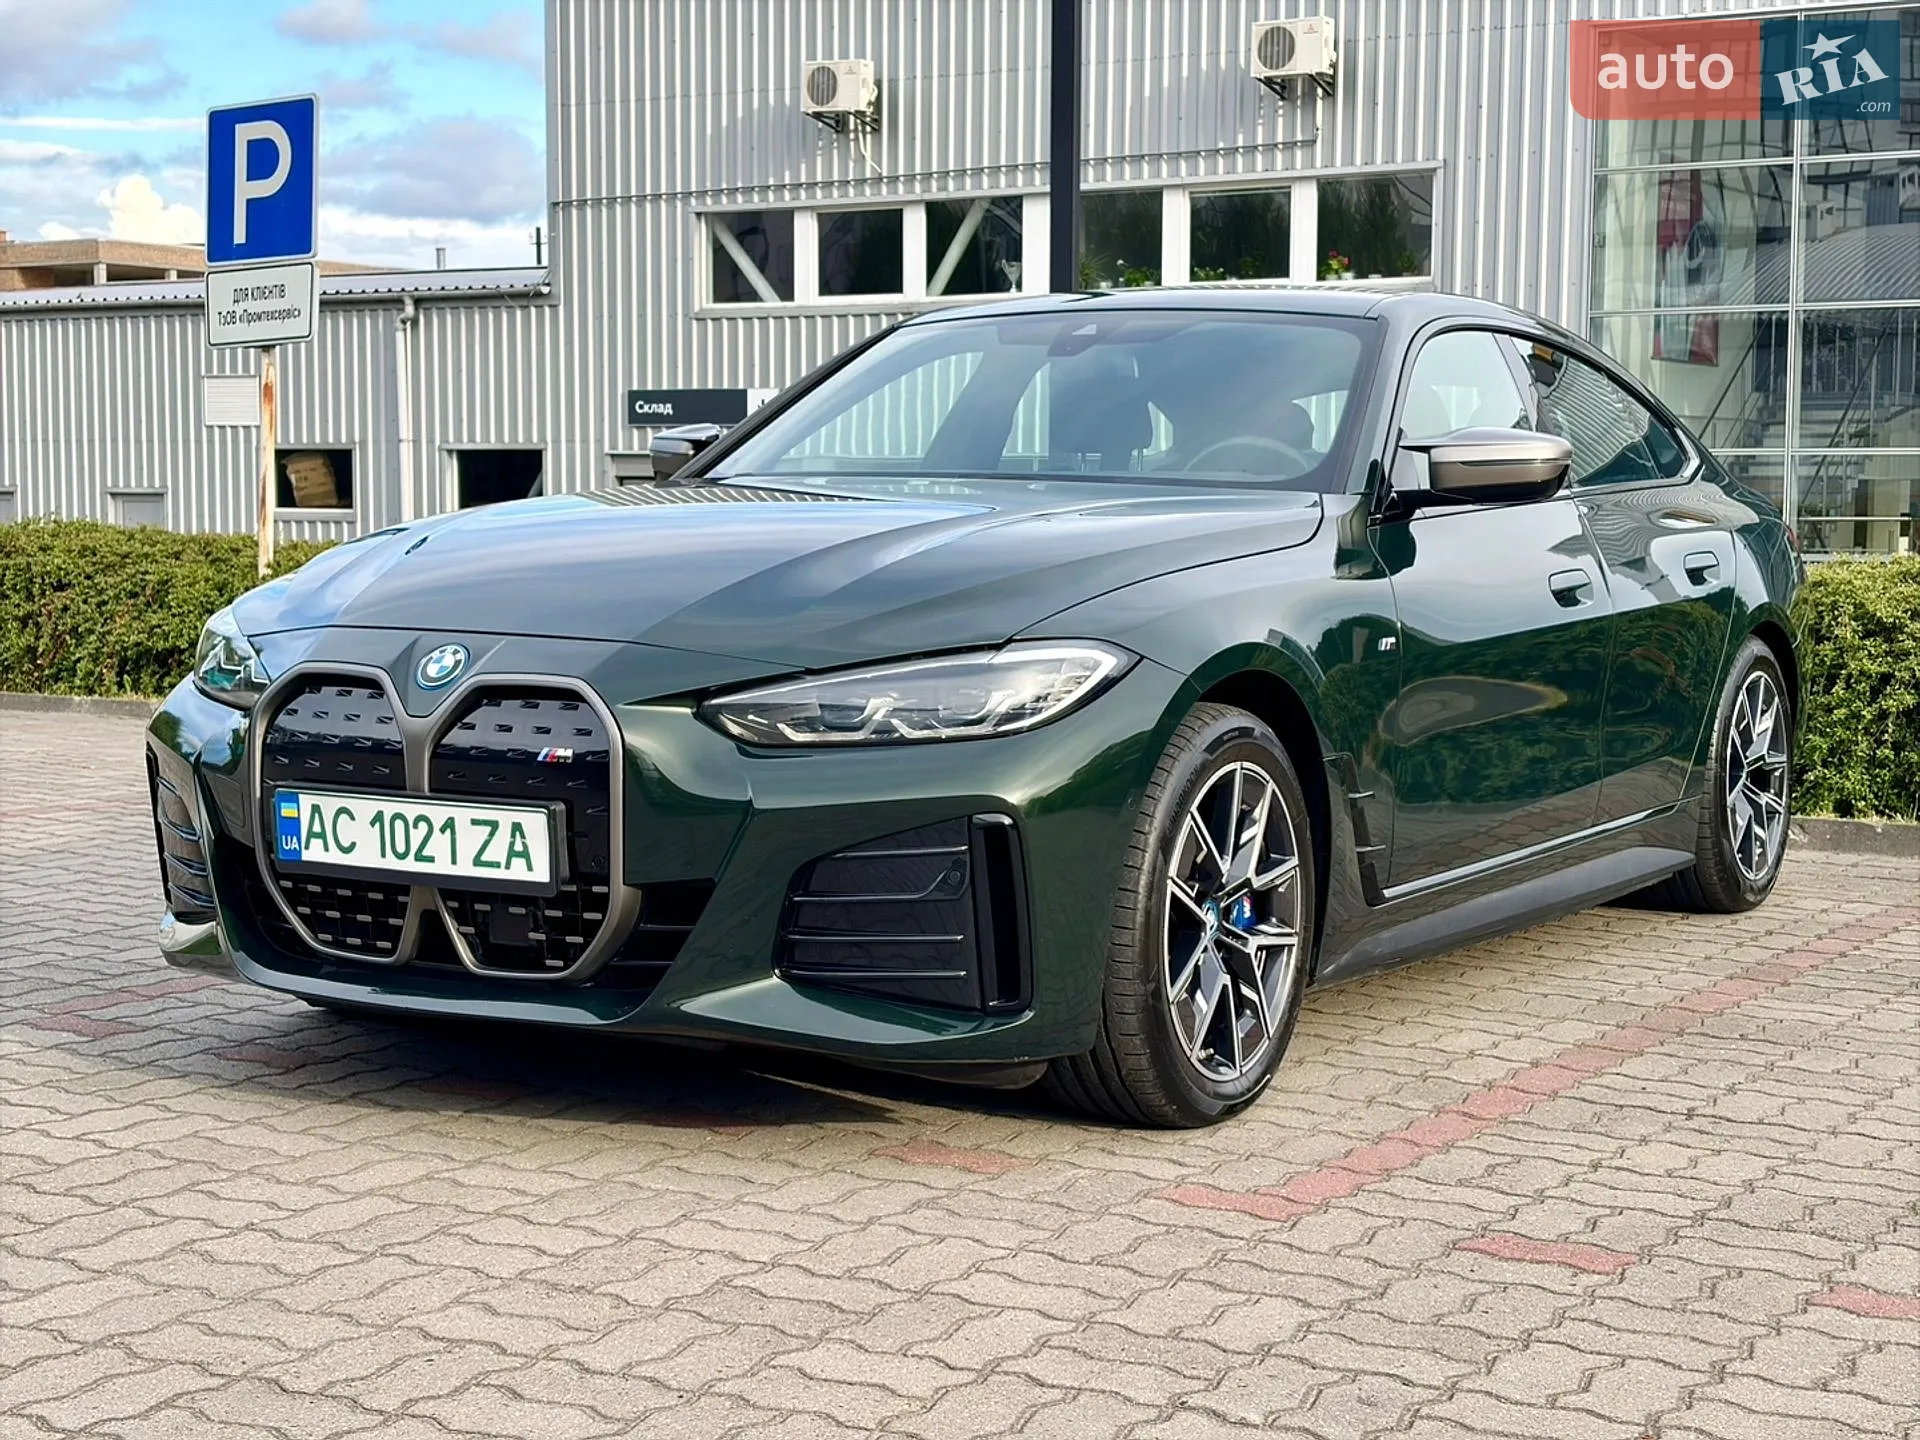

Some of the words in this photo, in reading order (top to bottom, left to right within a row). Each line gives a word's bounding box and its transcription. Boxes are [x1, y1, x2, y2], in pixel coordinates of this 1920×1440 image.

[233, 119, 292, 245] P
[233, 287, 249, 305] ДЛЯ
[250, 284, 286, 301] КЛІЄНТІВ
[635, 400, 673, 415] Склад
[282, 835, 299, 850] UA
[304, 803, 357, 854] AC
[369, 810, 457, 865] 1021
[470, 818, 534, 872] ZA
